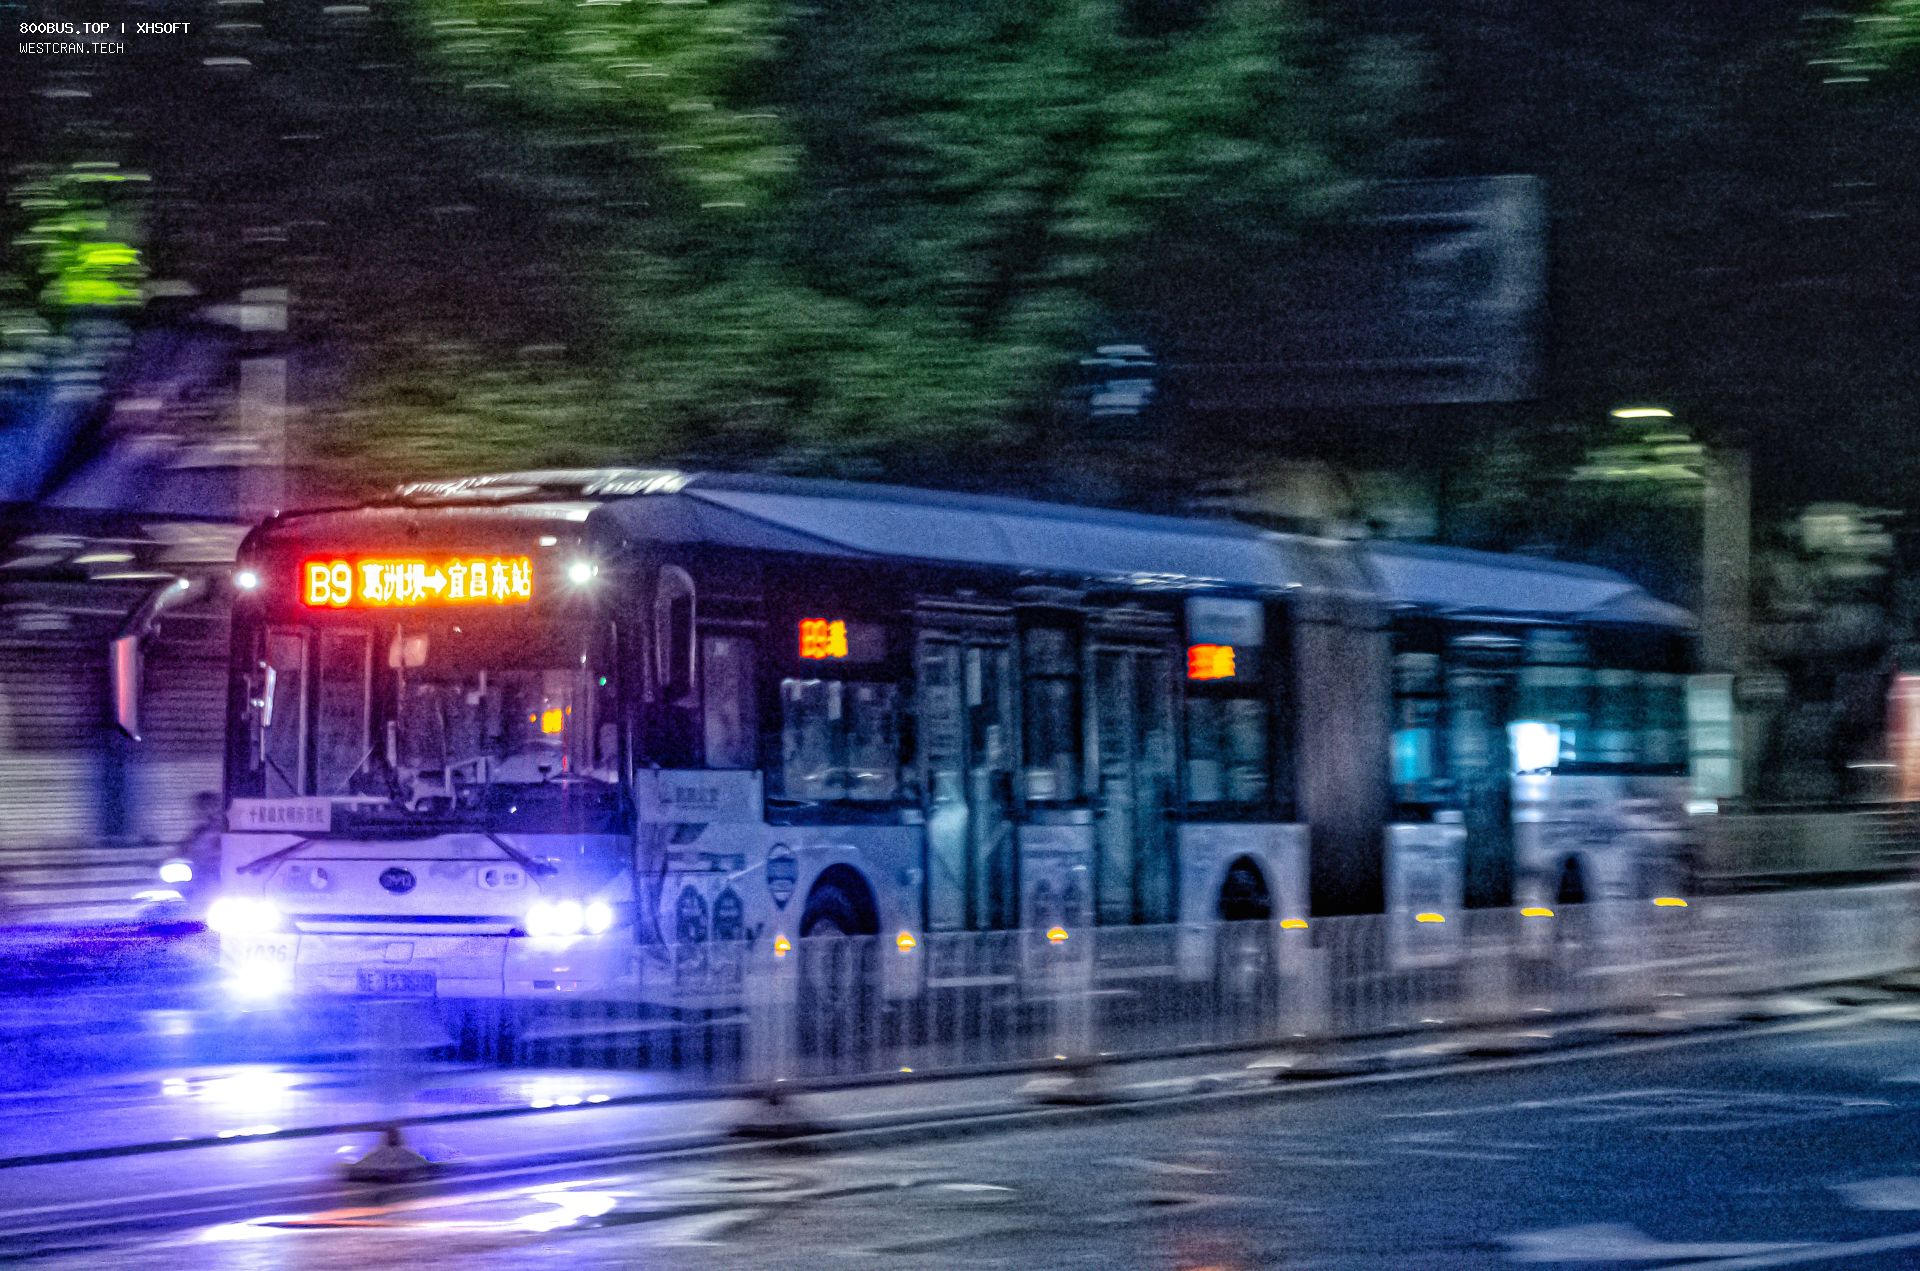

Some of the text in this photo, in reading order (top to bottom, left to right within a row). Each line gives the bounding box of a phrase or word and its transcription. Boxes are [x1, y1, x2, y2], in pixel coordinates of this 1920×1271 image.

[310, 563, 352, 604] B9
[448, 560, 533, 601] 宜昌东站
